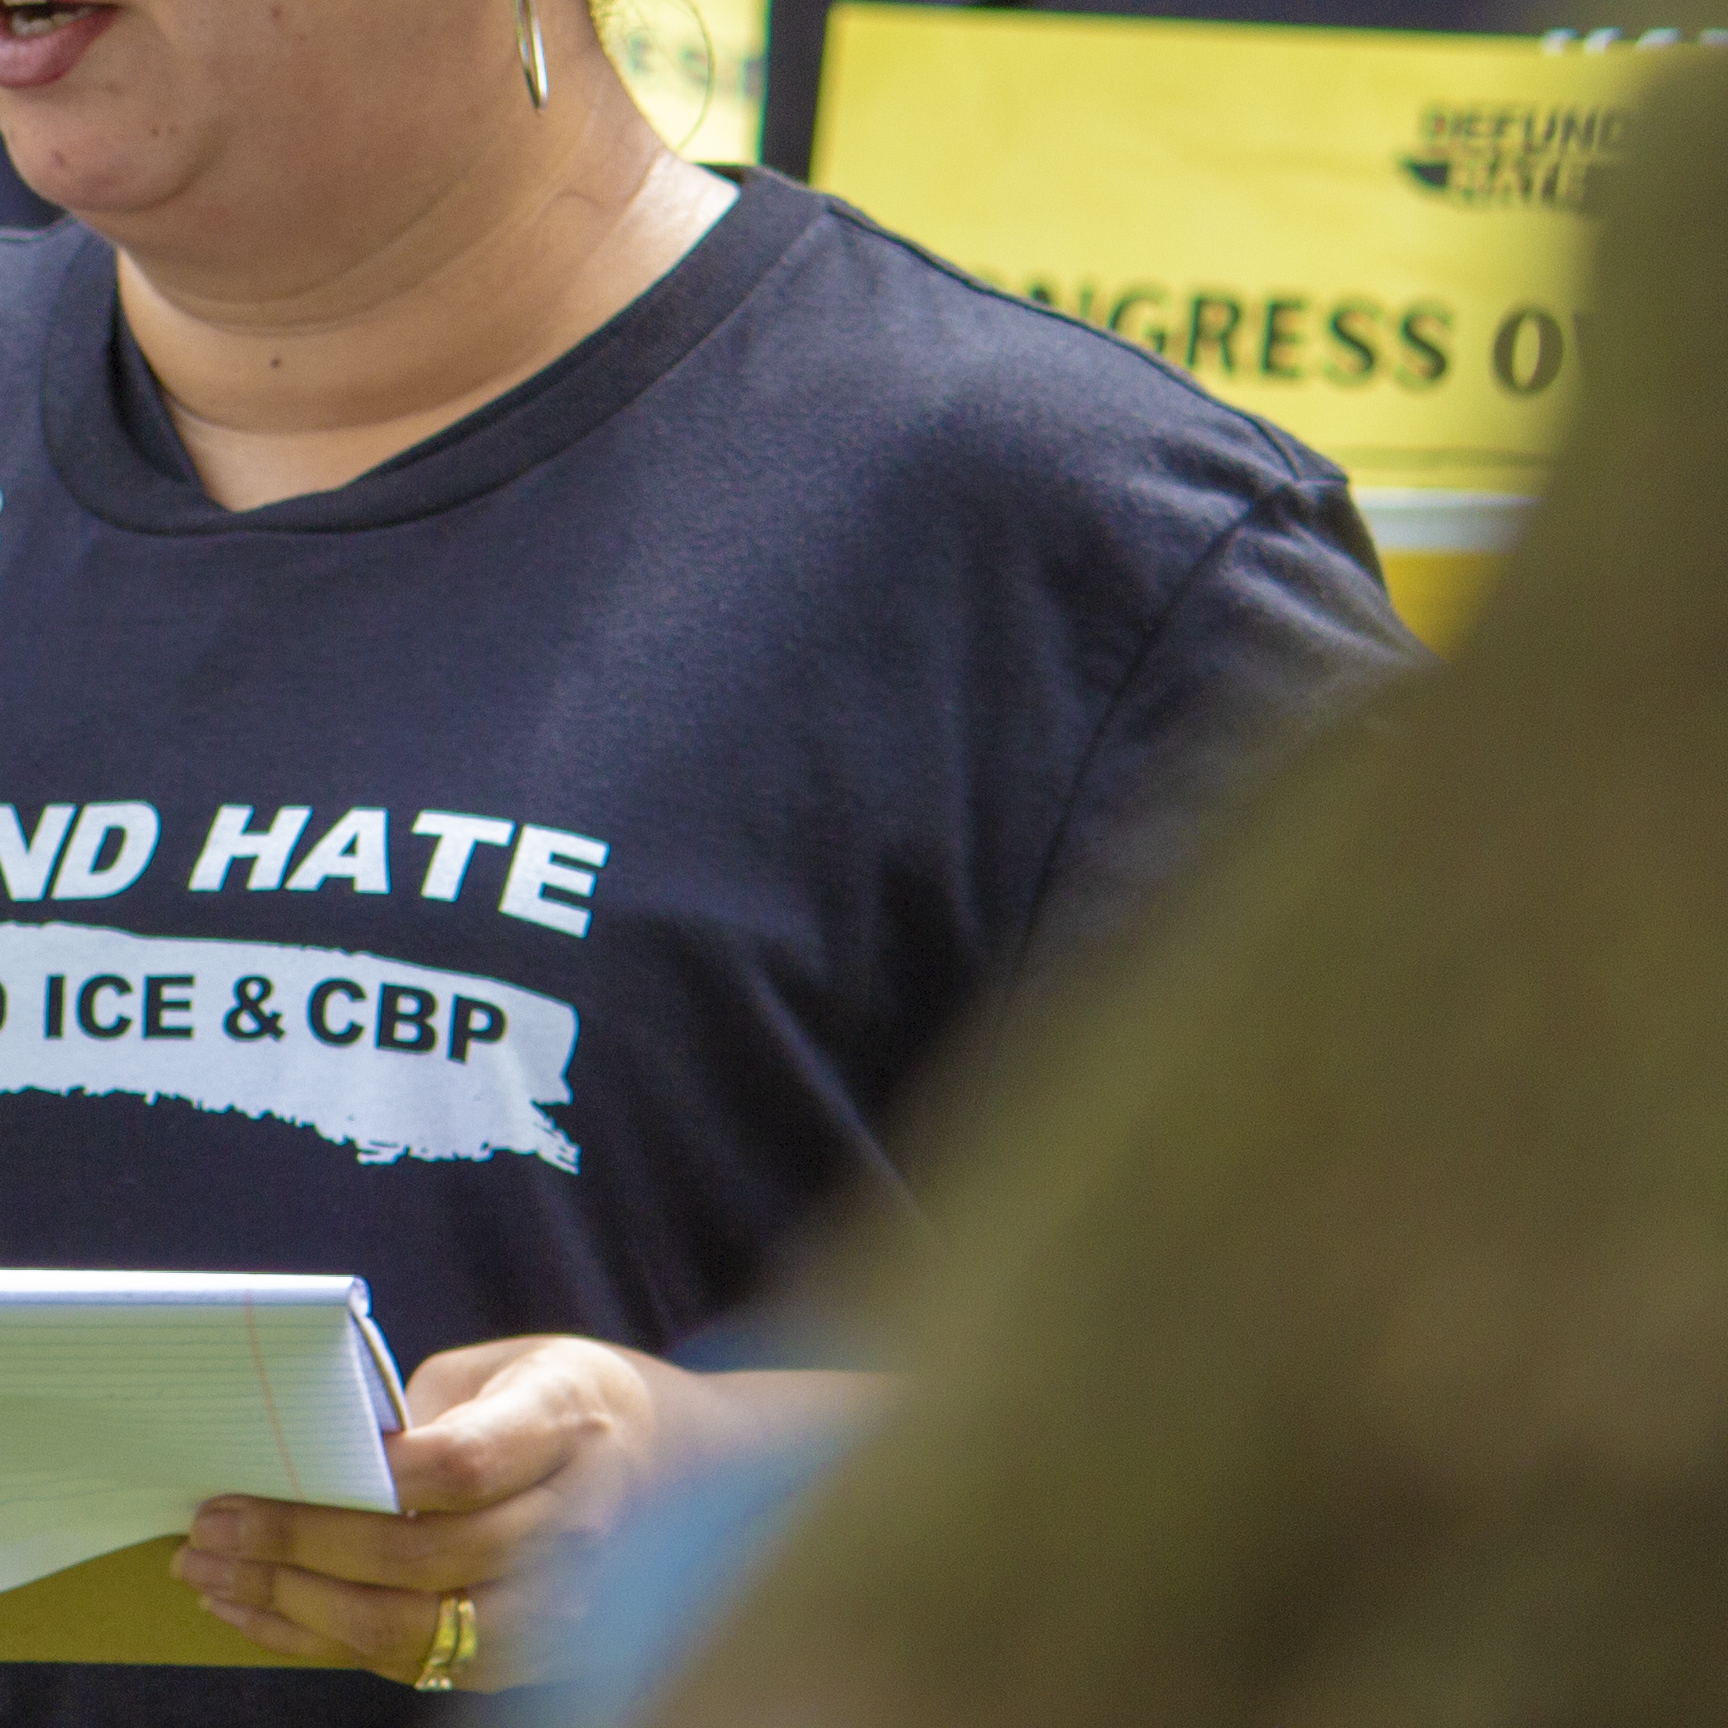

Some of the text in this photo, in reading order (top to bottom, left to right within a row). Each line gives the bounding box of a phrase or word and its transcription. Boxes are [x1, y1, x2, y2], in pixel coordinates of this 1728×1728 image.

[187, 803, 610, 940] HATE
[43, 974, 195, 1041] ICE
[222, 974, 286, 1041] &
[306, 977, 508, 1065] CBP
